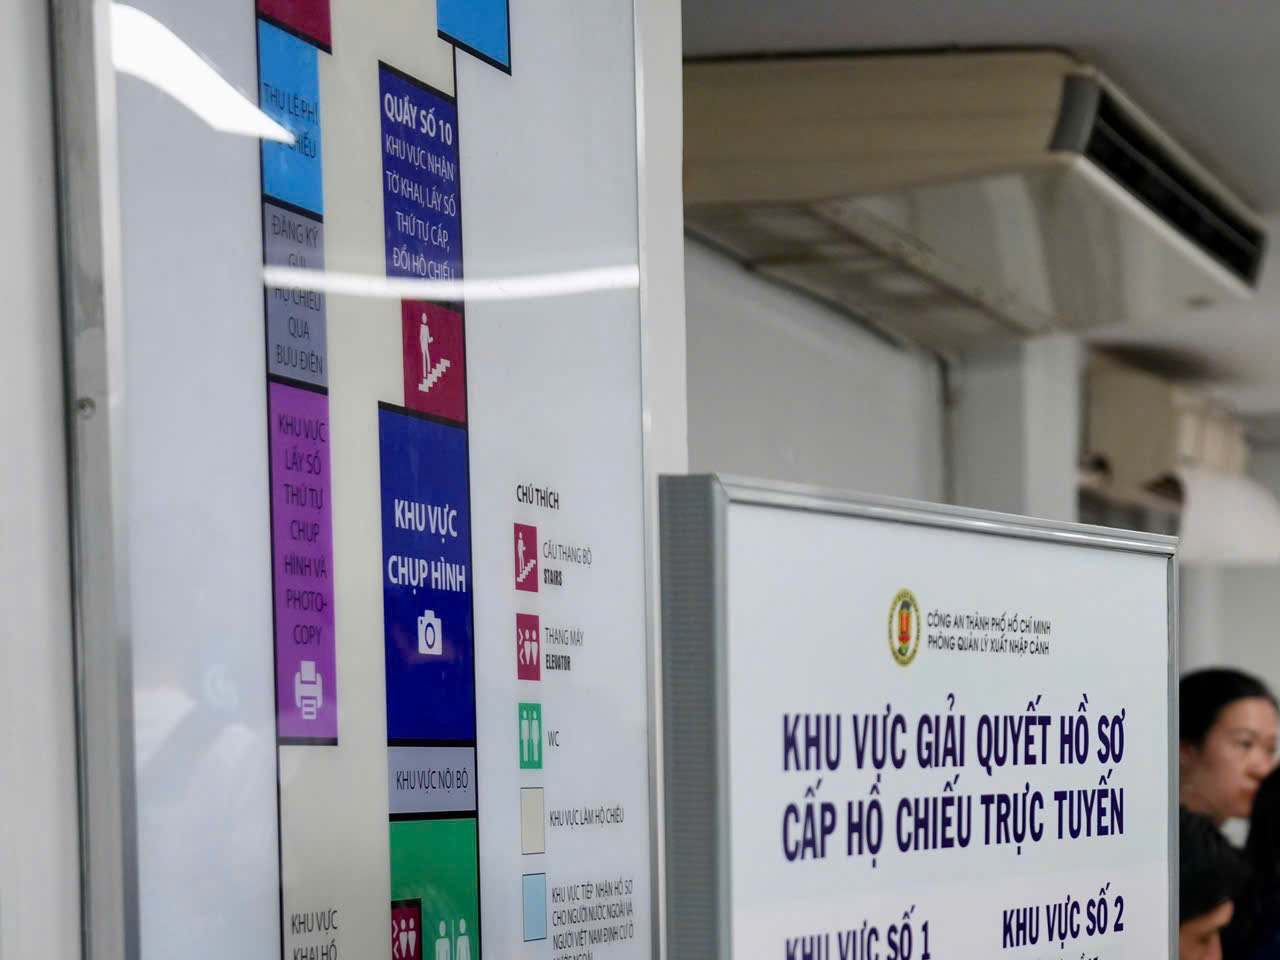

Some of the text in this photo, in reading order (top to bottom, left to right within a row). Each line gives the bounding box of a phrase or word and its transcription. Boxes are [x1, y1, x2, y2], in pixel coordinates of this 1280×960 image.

[384, 93, 452, 146] QUẦY SỐ 10
[386, 134, 454, 182] KHU VỰC NHẬN
[386, 170, 399, 193] TỜ
[426, 185, 442, 211] LẤY
[444, 193, 456, 216] SỐ
[395, 211, 416, 236] THỨ
[416, 219, 429, 245] TỰ
[278, 413, 326, 445] KHU VỰC
[306, 450, 321, 476] SỐ
[516, 484, 559, 510] CHÚ THÍCH
[394, 498, 458, 544] KHU VỰC
[558, 544, 581, 564] THANG
[388, 555, 466, 595] CHỤP HÌNH
[543, 568, 562, 586] STAIRS
[293, 624, 322, 645] COPY
[927, 609, 952, 629] CÔNG
[953, 614, 965, 629] AN
[966, 611, 989, 631] THÀNH
[991, 612, 1006, 632] PHỐ
[1020, 616, 1032, 634] CHÍ
[1033, 620, 1051, 635] MINH
[544, 627, 569, 646] THANG
[928, 631, 1049, 657] PHÒNG QUẢN LÝ XUẤT NHẬP CẢNH
[545, 654, 571, 671] ELEVATOR
[547, 730, 560, 747] WC
[783, 692, 1126, 783] KHU VỰC GIẢI QUYẾT HỒ SƠ
[396, 767, 469, 794] KHU VỰC NỘI BỘ
[783, 768, 1124, 868] CẤP HỘ CHIẾU TRỰC TUYẾN
[291, 908, 338, 935] KHU VỰC
[1002, 882, 1124, 949] KHU VỰC SỐ 2
[921, 920, 931, 960] 1
